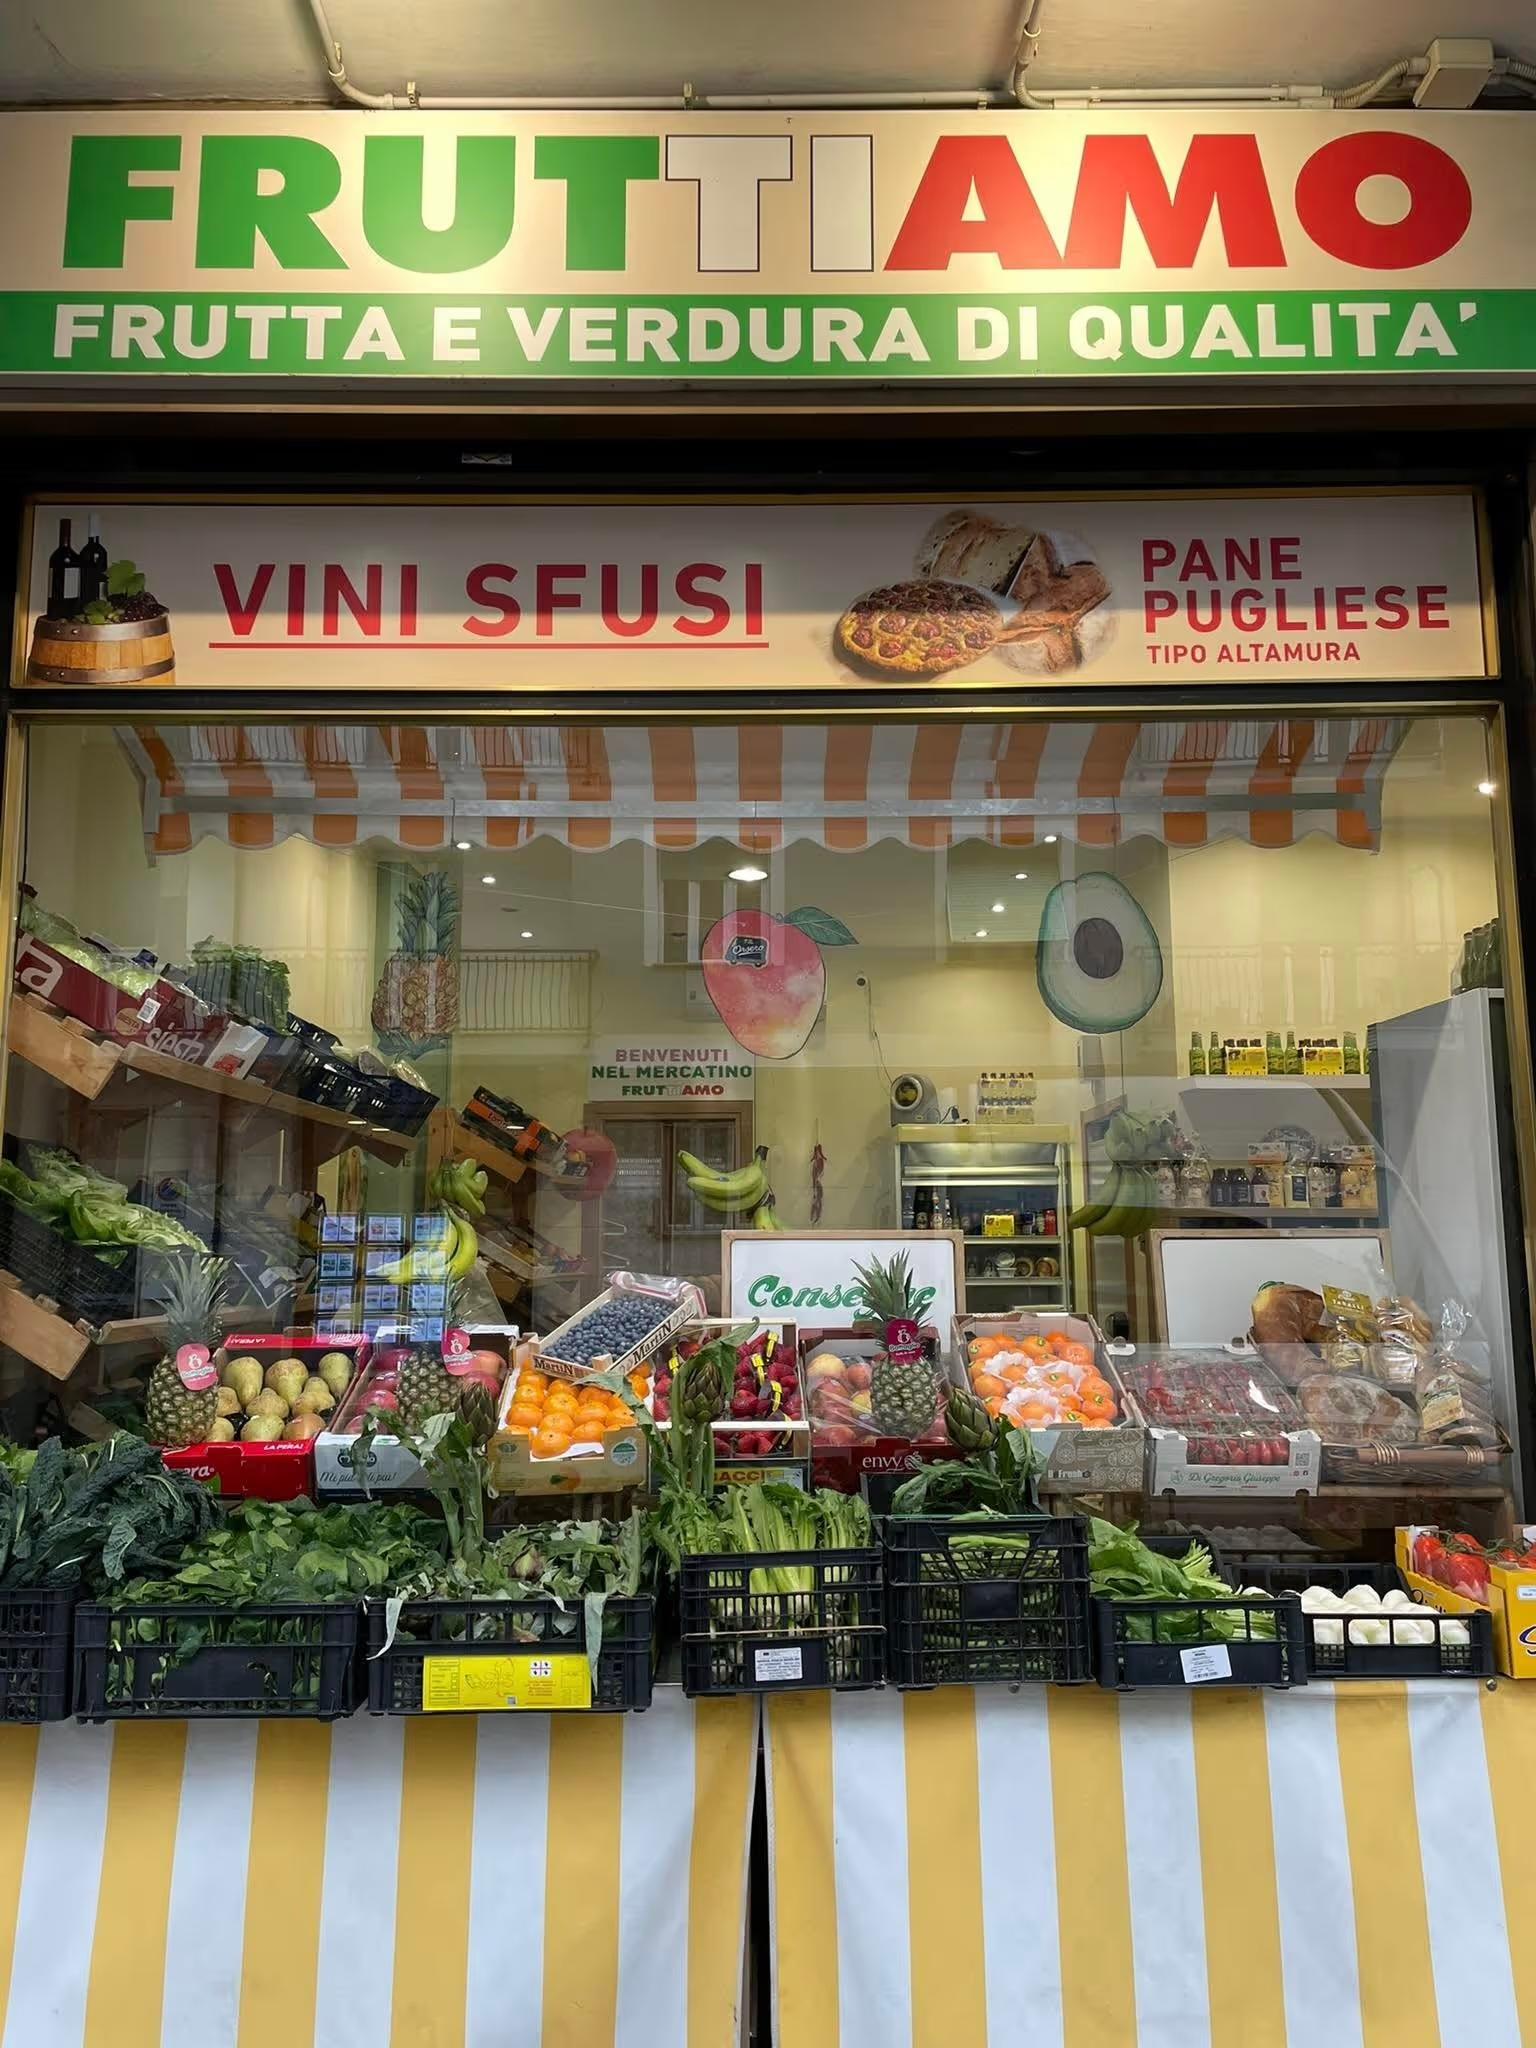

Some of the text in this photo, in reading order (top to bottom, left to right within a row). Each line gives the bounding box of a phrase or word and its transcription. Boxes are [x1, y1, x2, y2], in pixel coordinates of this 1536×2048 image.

[62, 131, 1473, 274] FRUTTIAMO
[53, 304, 405, 361] FRUTTA
[432, 307, 482, 362] E
[507, 306, 931, 363] VERDURA
[957, 305, 1038, 361] DI
[1142, 536, 1303, 582] PANE
[212, 562, 763, 637] VINI SFUSI
[1143, 585, 1451, 634] PUGLIESE
[1146, 641, 1362, 665] TIPO ALTAMURA
[591, 1064, 753, 1079] NEL MERCATINO
[615, 1048, 728, 1063] BENVENUTI
[862, 1454, 903, 1471] envy
